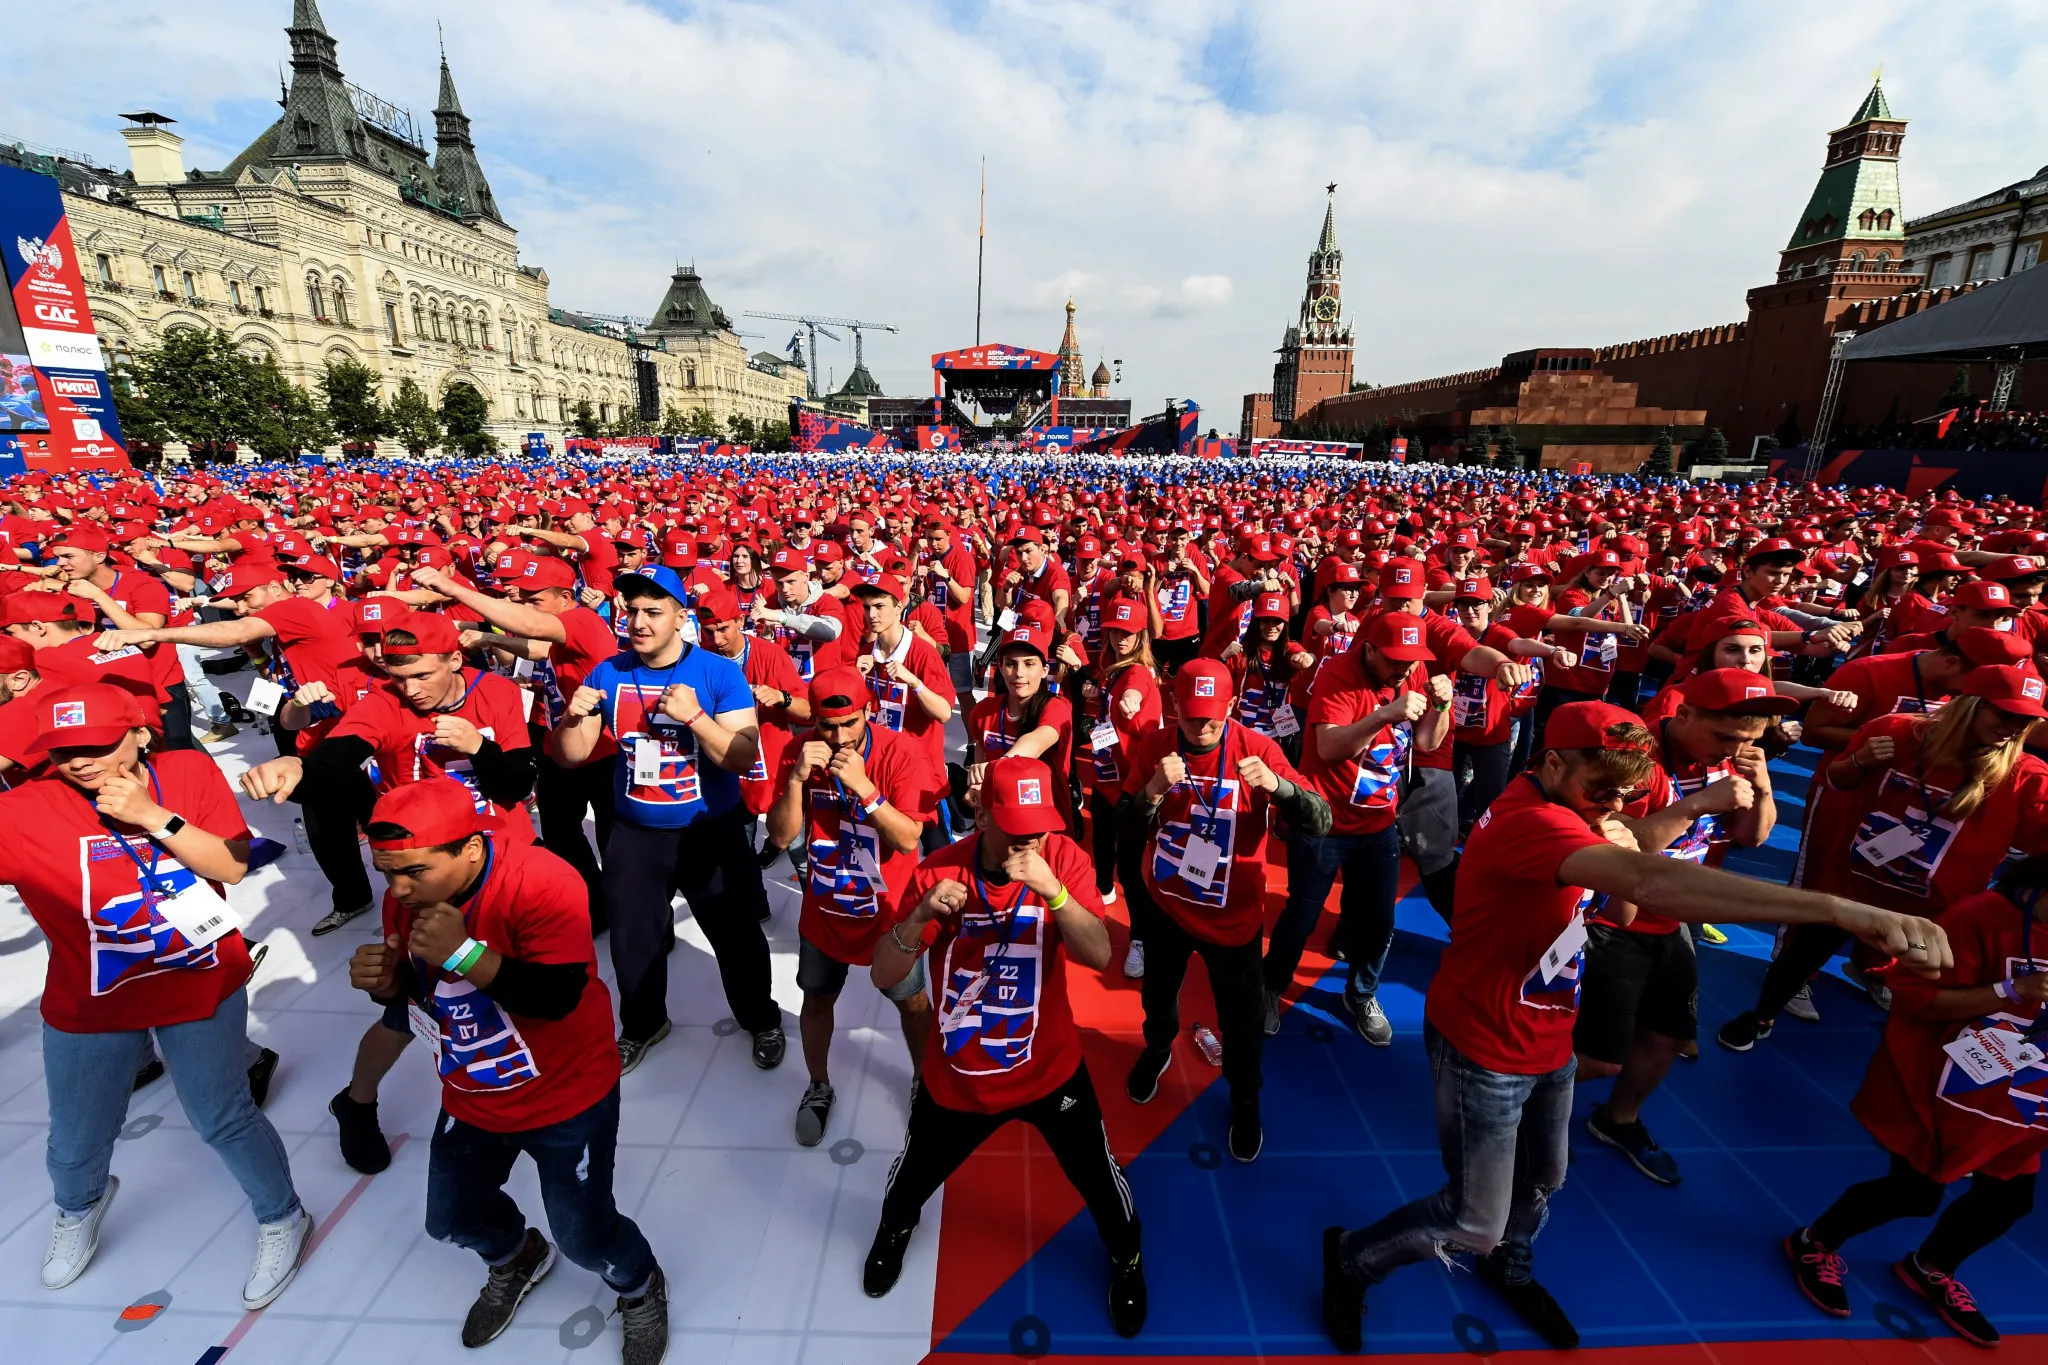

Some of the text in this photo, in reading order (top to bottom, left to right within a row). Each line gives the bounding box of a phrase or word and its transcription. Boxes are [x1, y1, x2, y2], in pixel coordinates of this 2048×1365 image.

[56, 381, 96, 394] МАТЧ!
[615, 437, 661, 448] РЕКОРД
[661, 728, 678, 738] 22
[664, 740, 679, 752] 07
[1200, 822, 1217, 835] 22
[999, 964, 1019, 980] 22
[998, 985, 1018, 1001] 07
[448, 1002, 474, 1020] 22
[458, 1022, 478, 1040] 07
[1965, 1046, 1993, 1071] 1642
[1972, 1031, 2017, 1073] УЧАСТНИК
